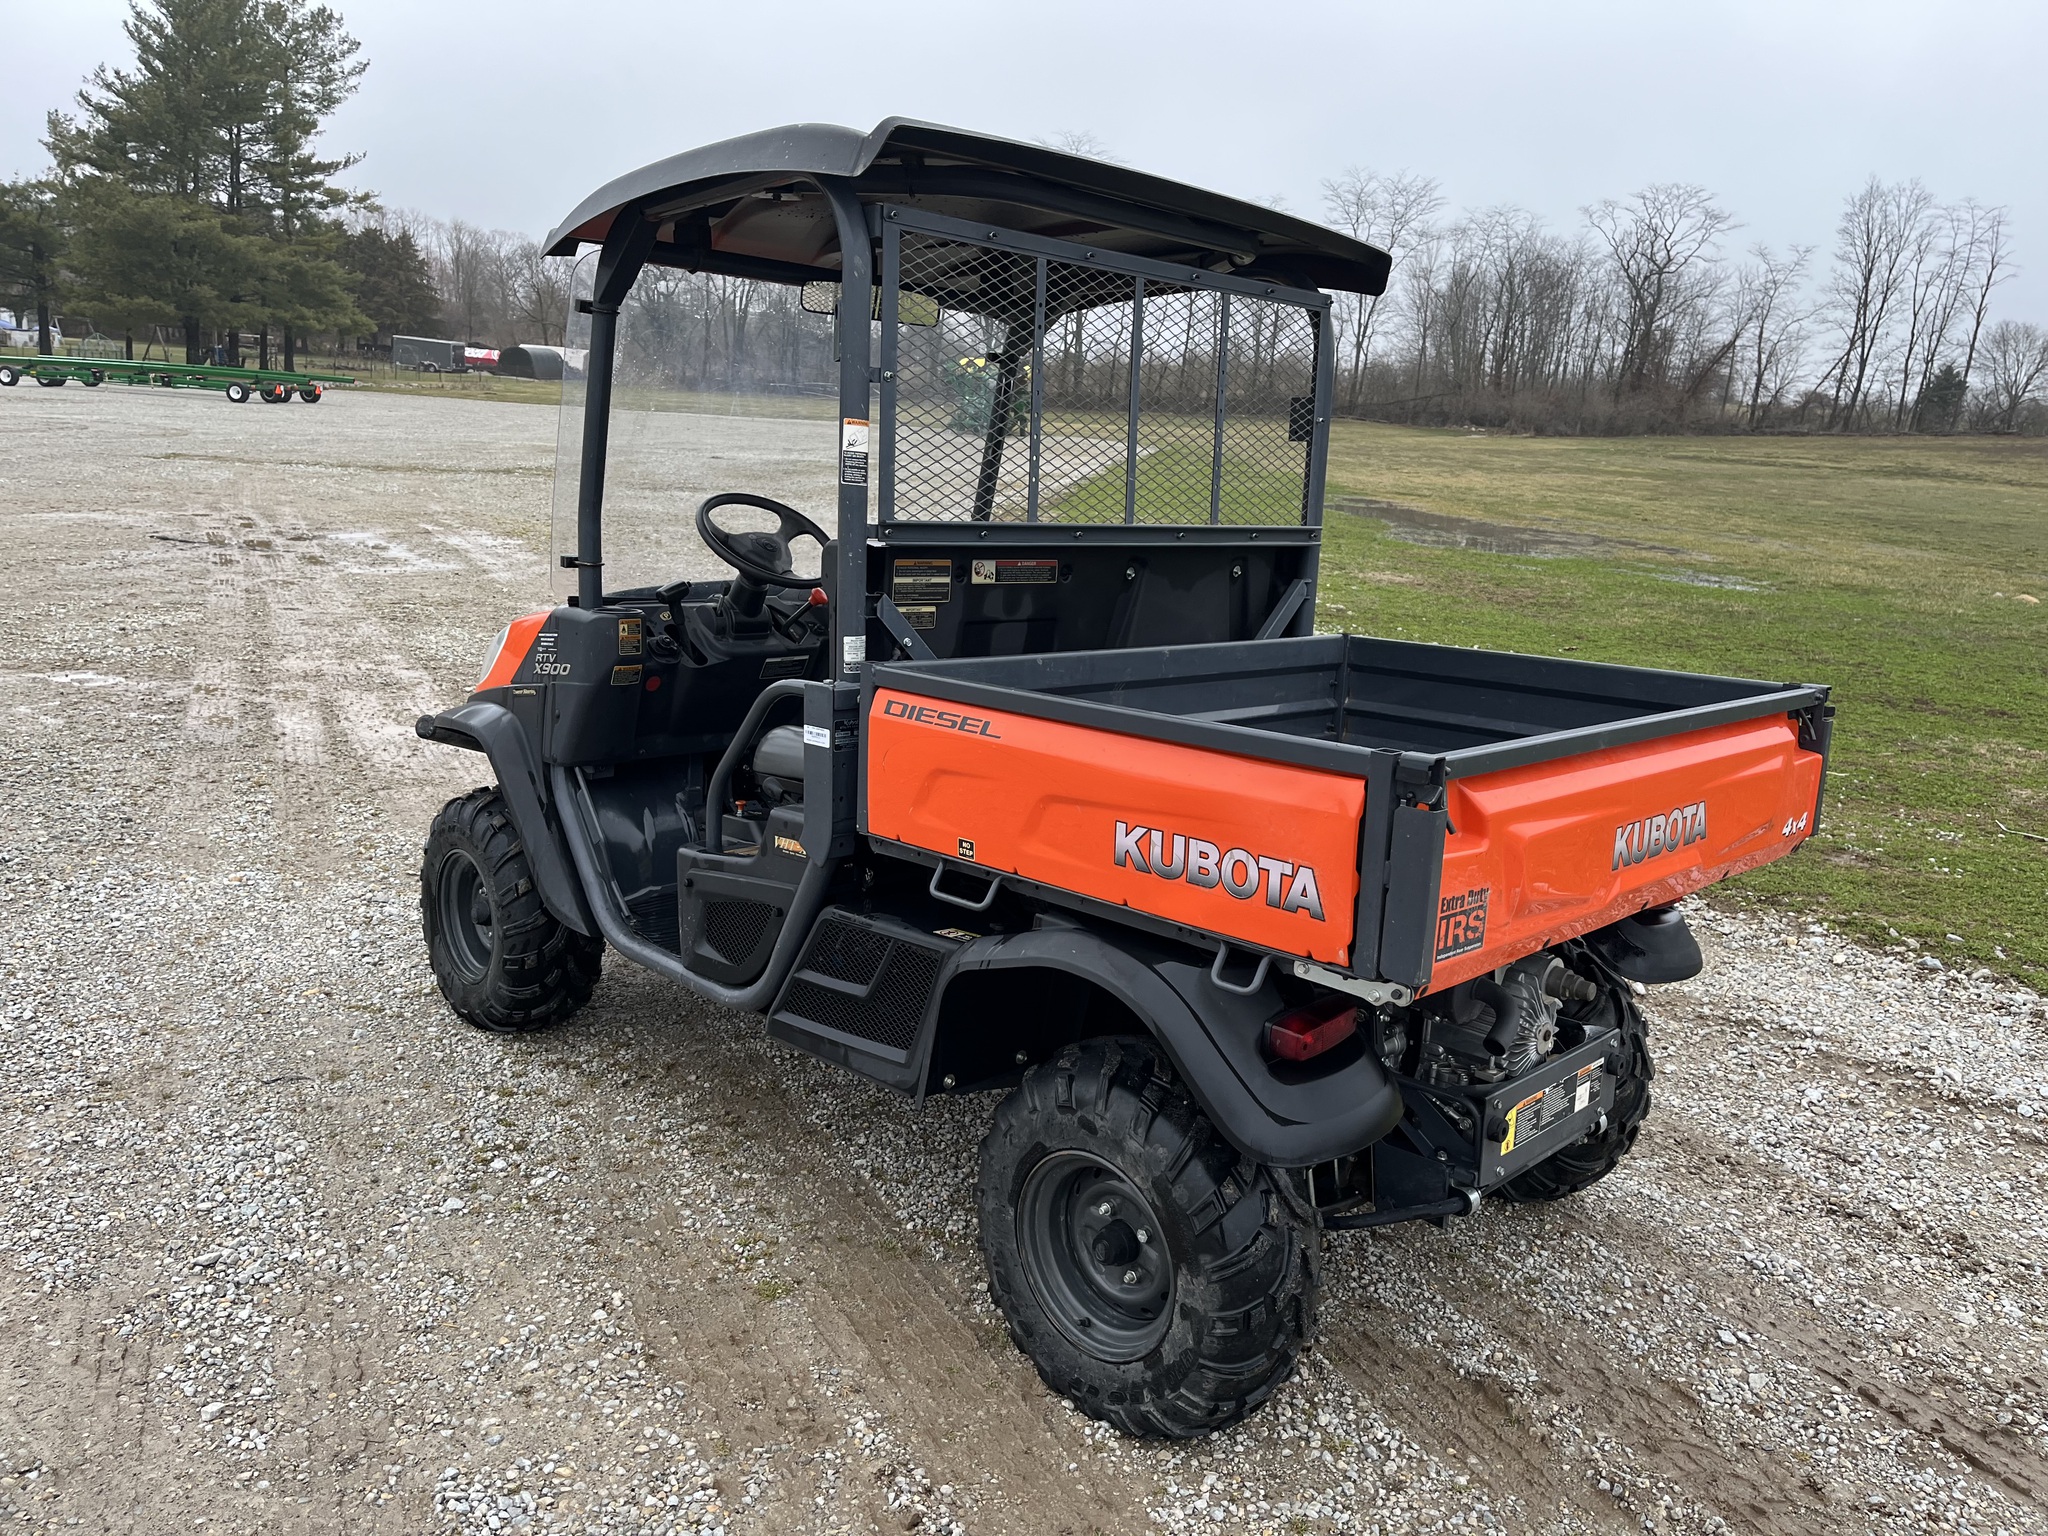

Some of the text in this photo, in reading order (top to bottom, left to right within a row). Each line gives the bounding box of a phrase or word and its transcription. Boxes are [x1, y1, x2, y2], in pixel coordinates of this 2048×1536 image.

[533, 663, 571, 676] X900
[535, 653, 557, 663] RTV
[883, 699, 1002, 739] DIESEL
[1611, 800, 1707, 871] KUBOTA
[1781, 811, 1808, 838] 4x4
[959, 848, 973, 856] STEP
[962, 841, 971, 849] NO
[1114, 819, 1326, 922] KUBOTA
[1441, 888, 1489, 914] Extra Duty
[1438, 910, 1485, 950] IRS
